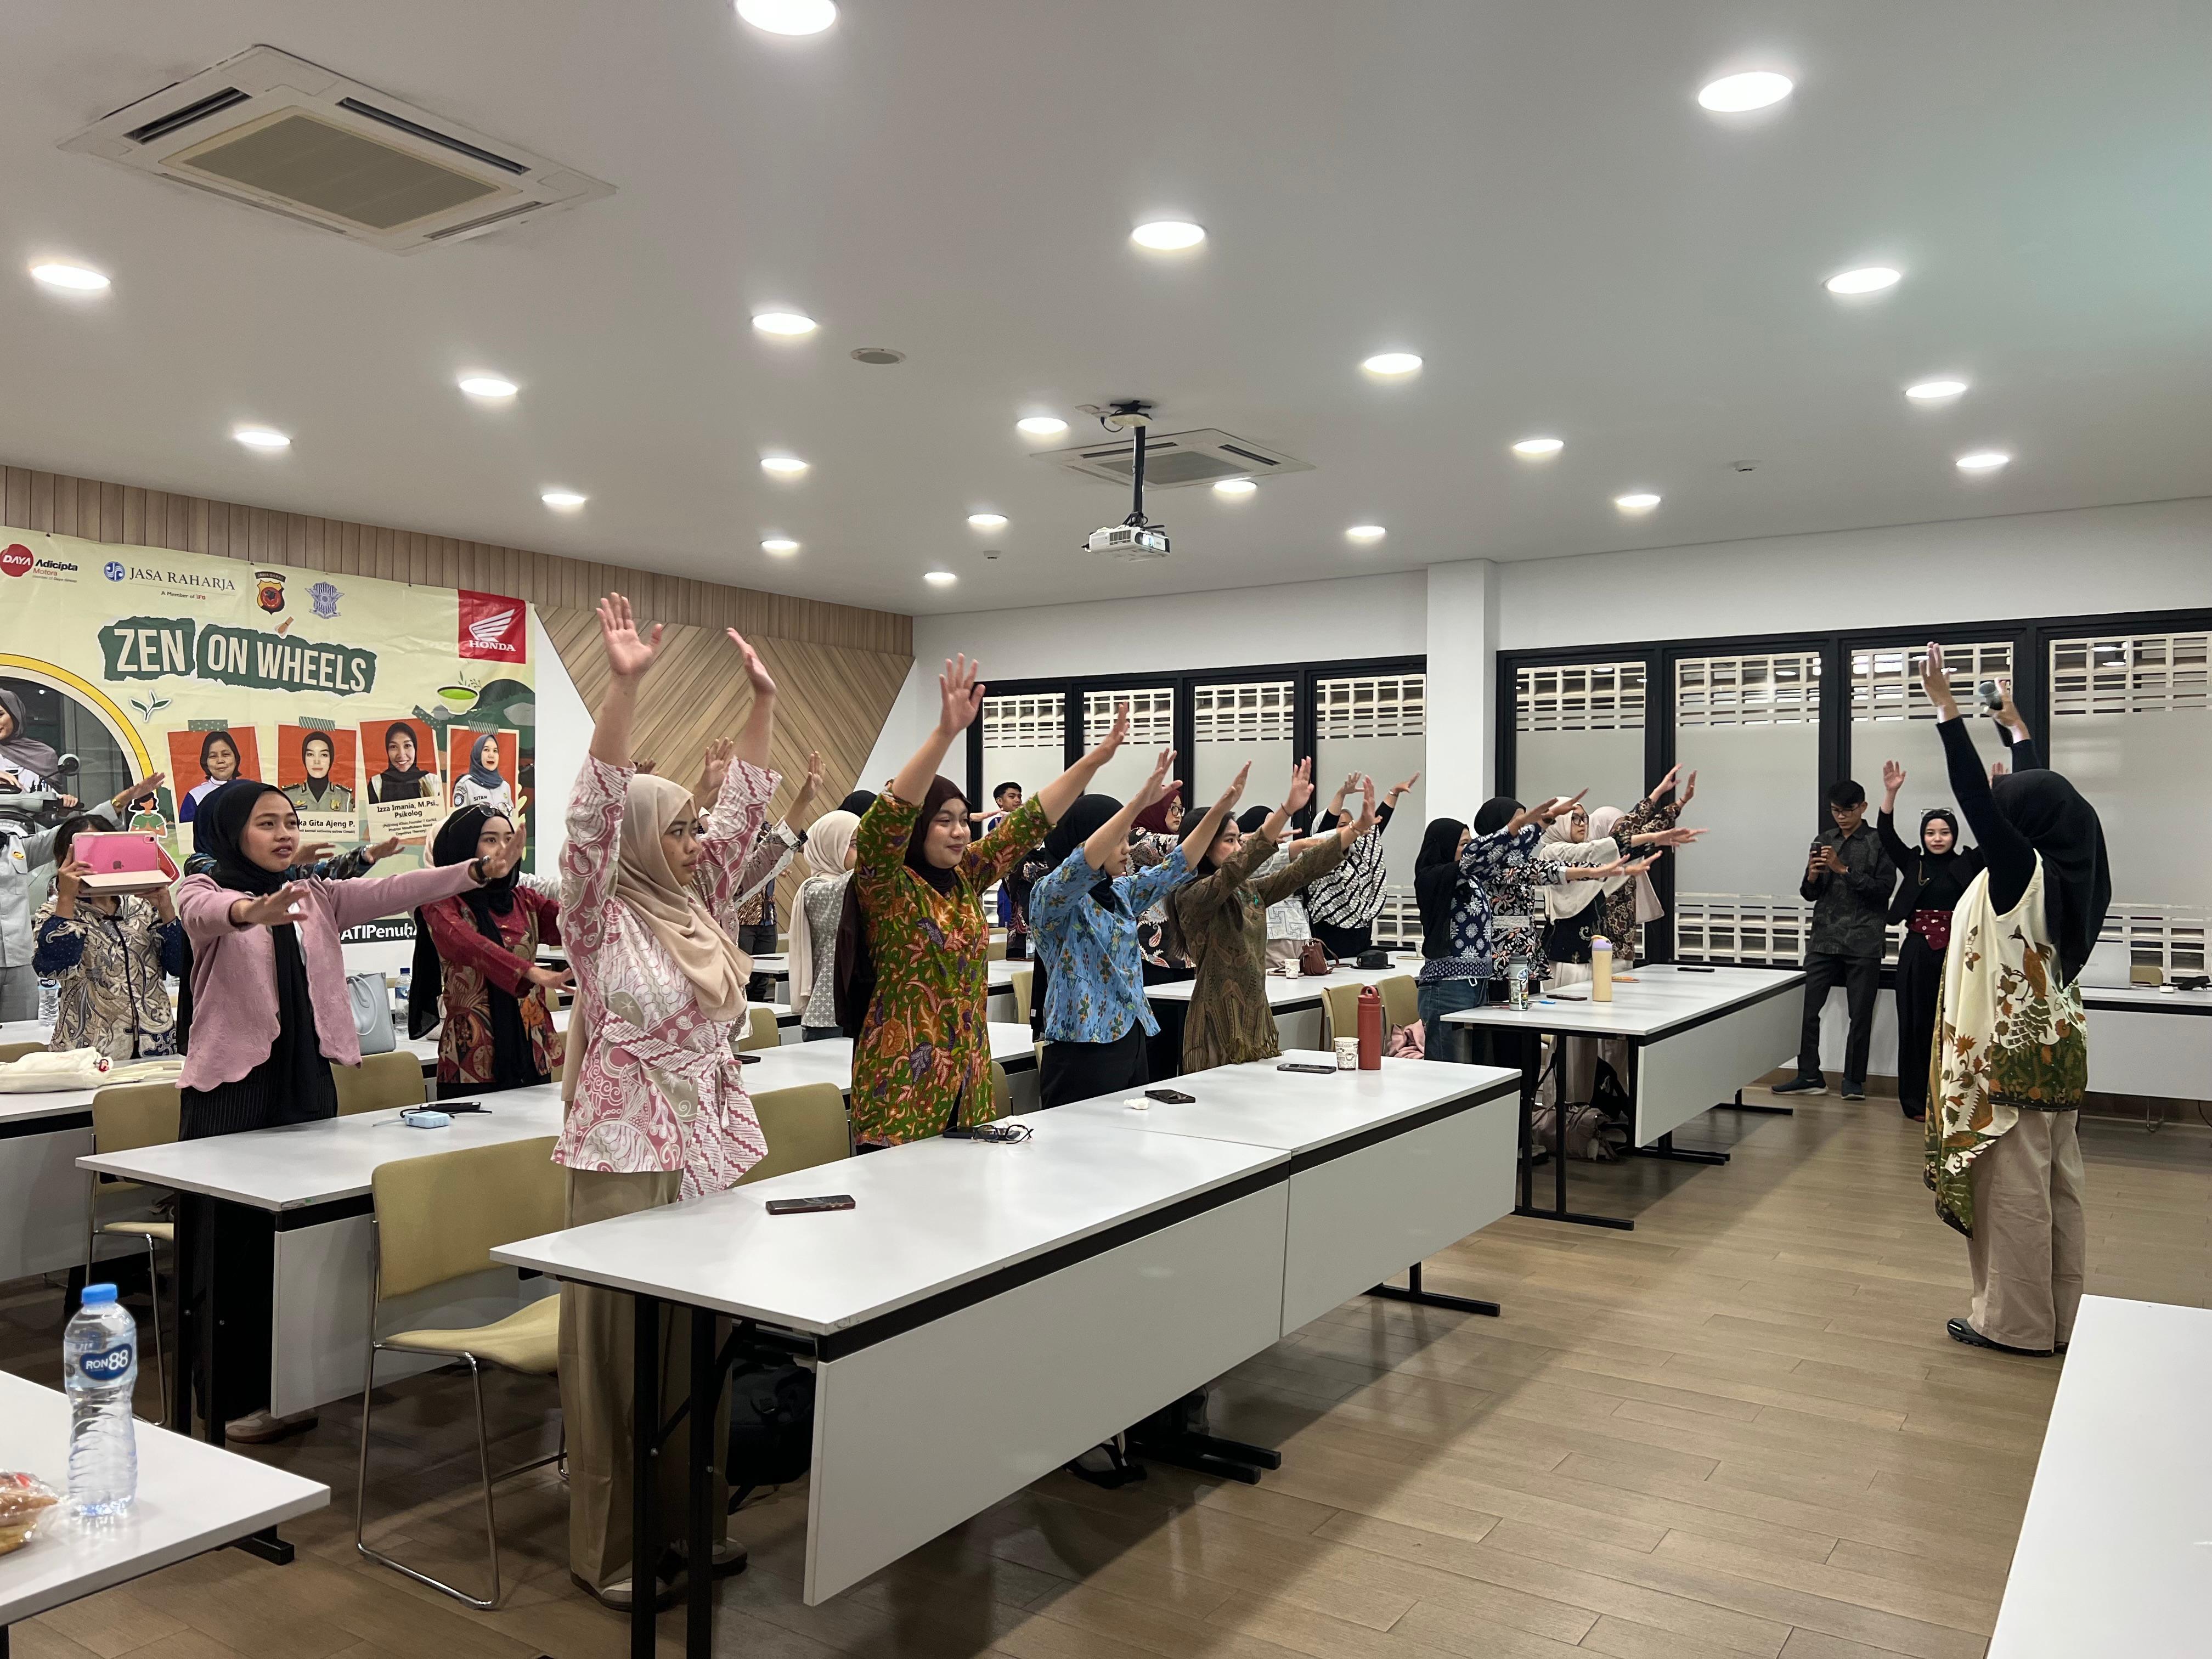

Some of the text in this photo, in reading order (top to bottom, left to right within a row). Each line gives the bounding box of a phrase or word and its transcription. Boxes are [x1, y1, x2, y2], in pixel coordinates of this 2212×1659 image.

[3, 555, 31, 566] DAYA
[35, 559, 78, 571] Adicipta
[33, 568, 58, 576] Motora
[129, 567, 235, 591] JASA RAHARJA
[469, 640, 517, 652] HONDA
[114, 629, 366, 692] ZEN ON WHEELS
[325, 820, 347, 829] Ajeng
[338, 922, 417, 940] ATIPenuh
